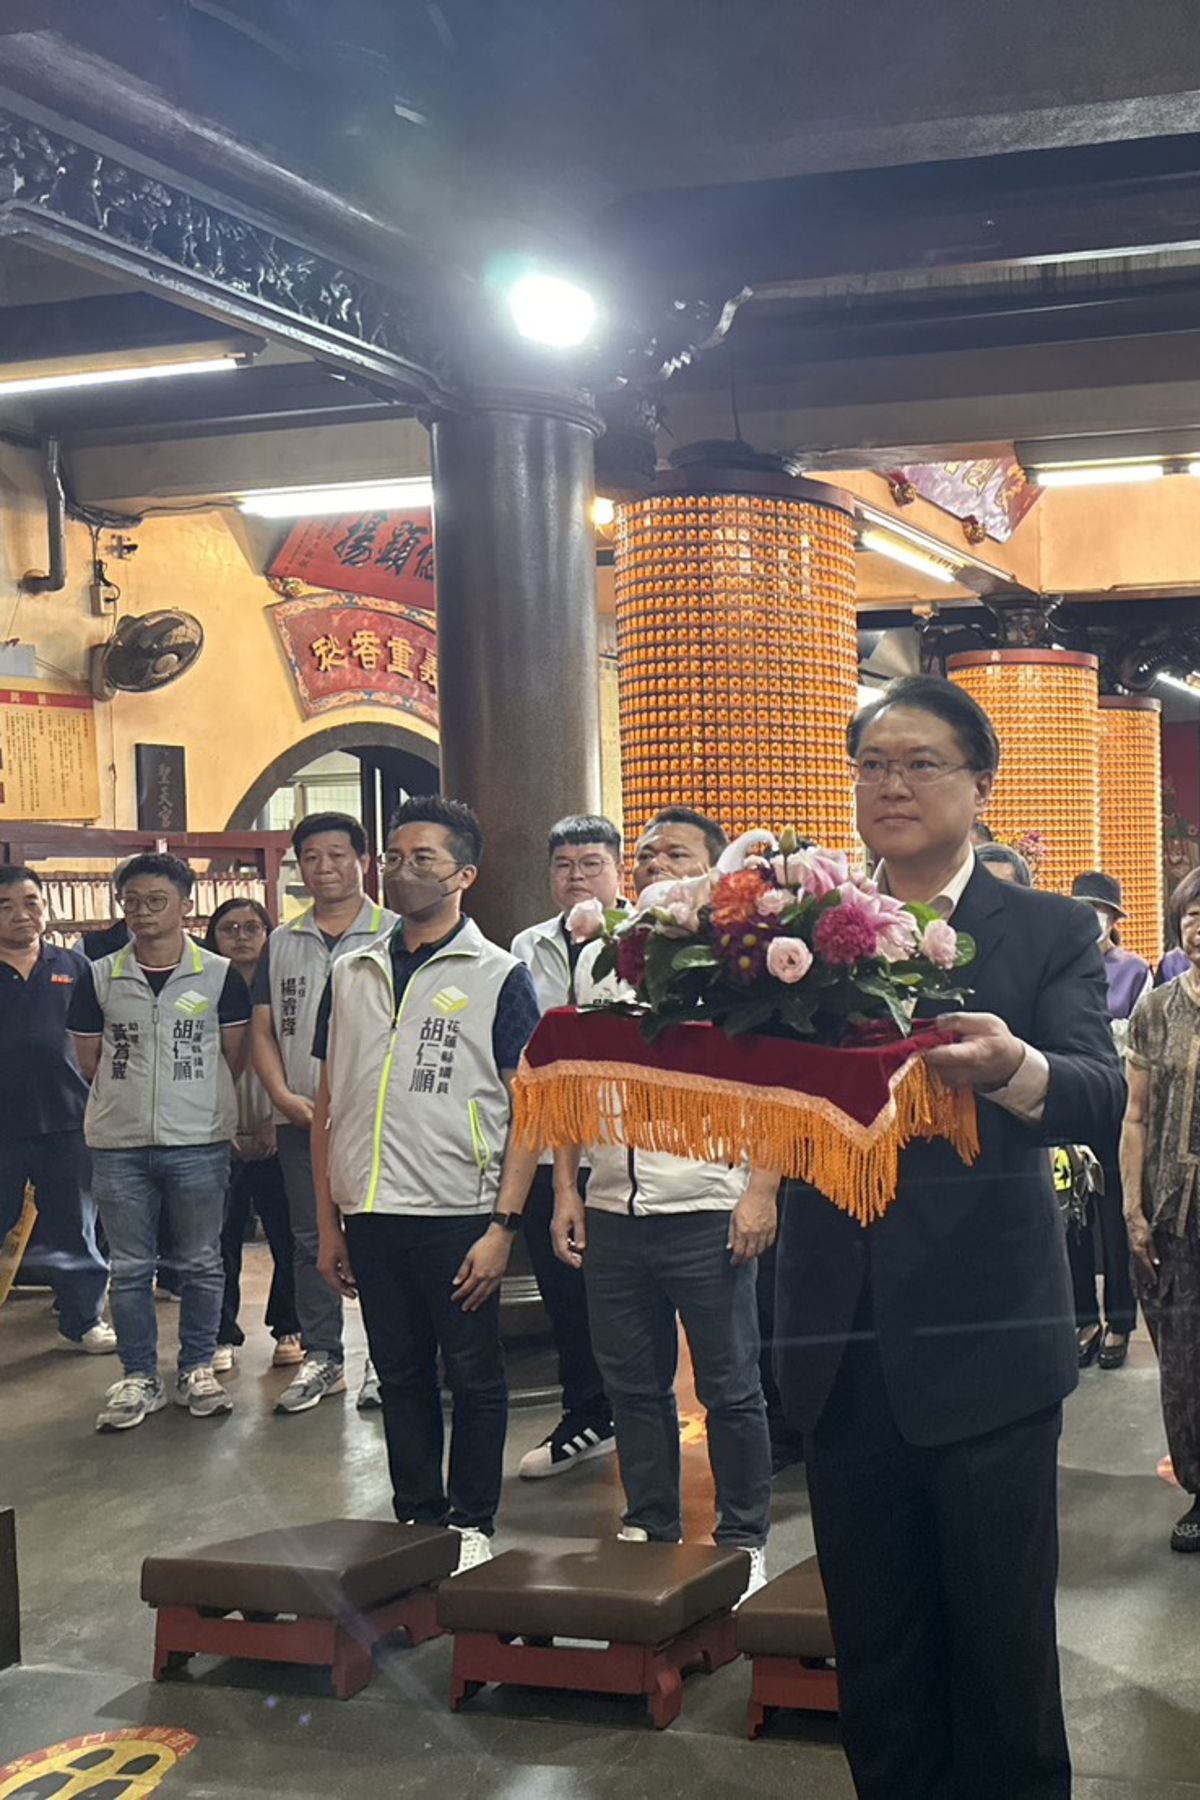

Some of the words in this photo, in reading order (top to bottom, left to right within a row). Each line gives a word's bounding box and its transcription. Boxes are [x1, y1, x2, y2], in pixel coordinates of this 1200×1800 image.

[173, 1019, 194, 1081] 胡仁順
[408, 1016, 445, 1094] 胡仁順
